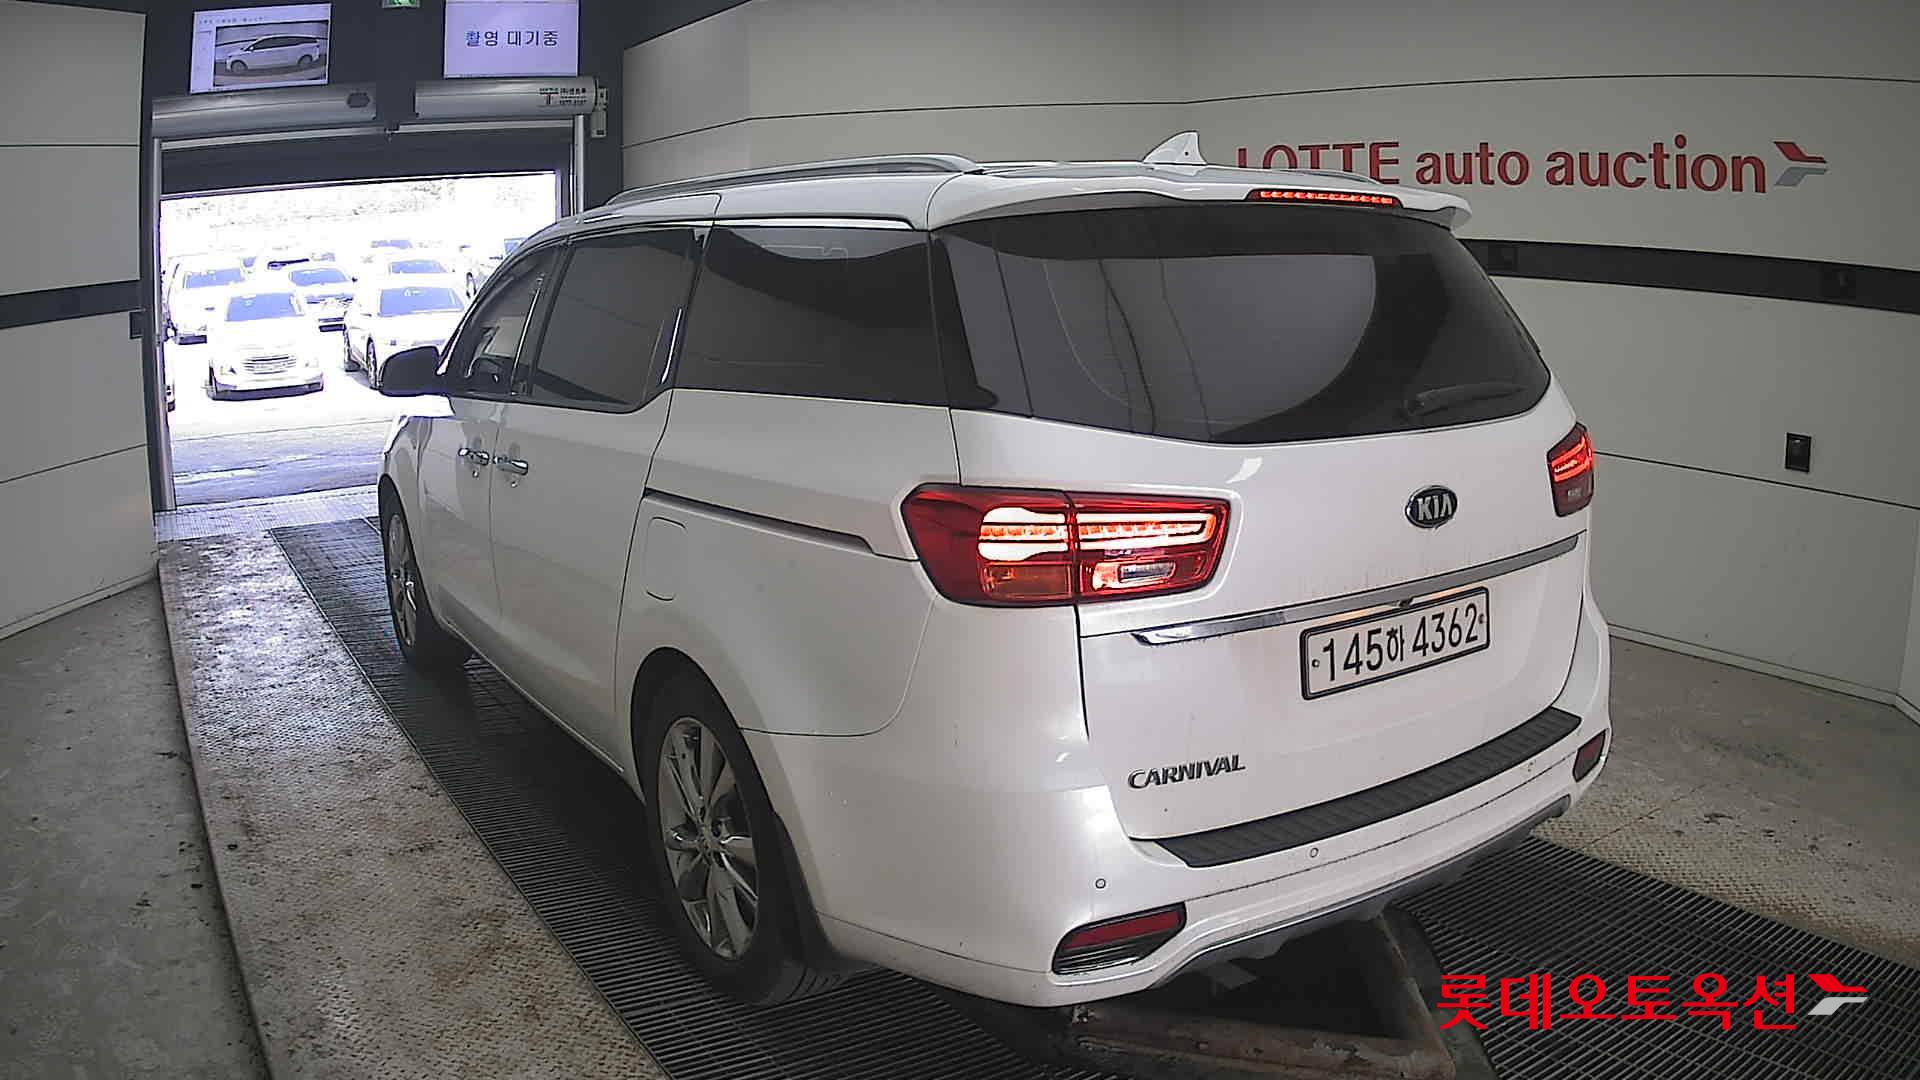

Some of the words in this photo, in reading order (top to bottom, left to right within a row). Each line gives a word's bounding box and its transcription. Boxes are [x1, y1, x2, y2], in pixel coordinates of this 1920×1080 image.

[465, 30, 498, 47] 촬영
[507, 30, 557, 46] 대기중
[1415, 142, 1530, 186] auto
[1545, 134, 1766, 193] auction
[1416, 493, 1453, 521] KIA
[1322, 625, 1405, 681] 145하
[1412, 603, 1478, 657] 4362
[1127, 754, 1247, 789] CARNIVAL
